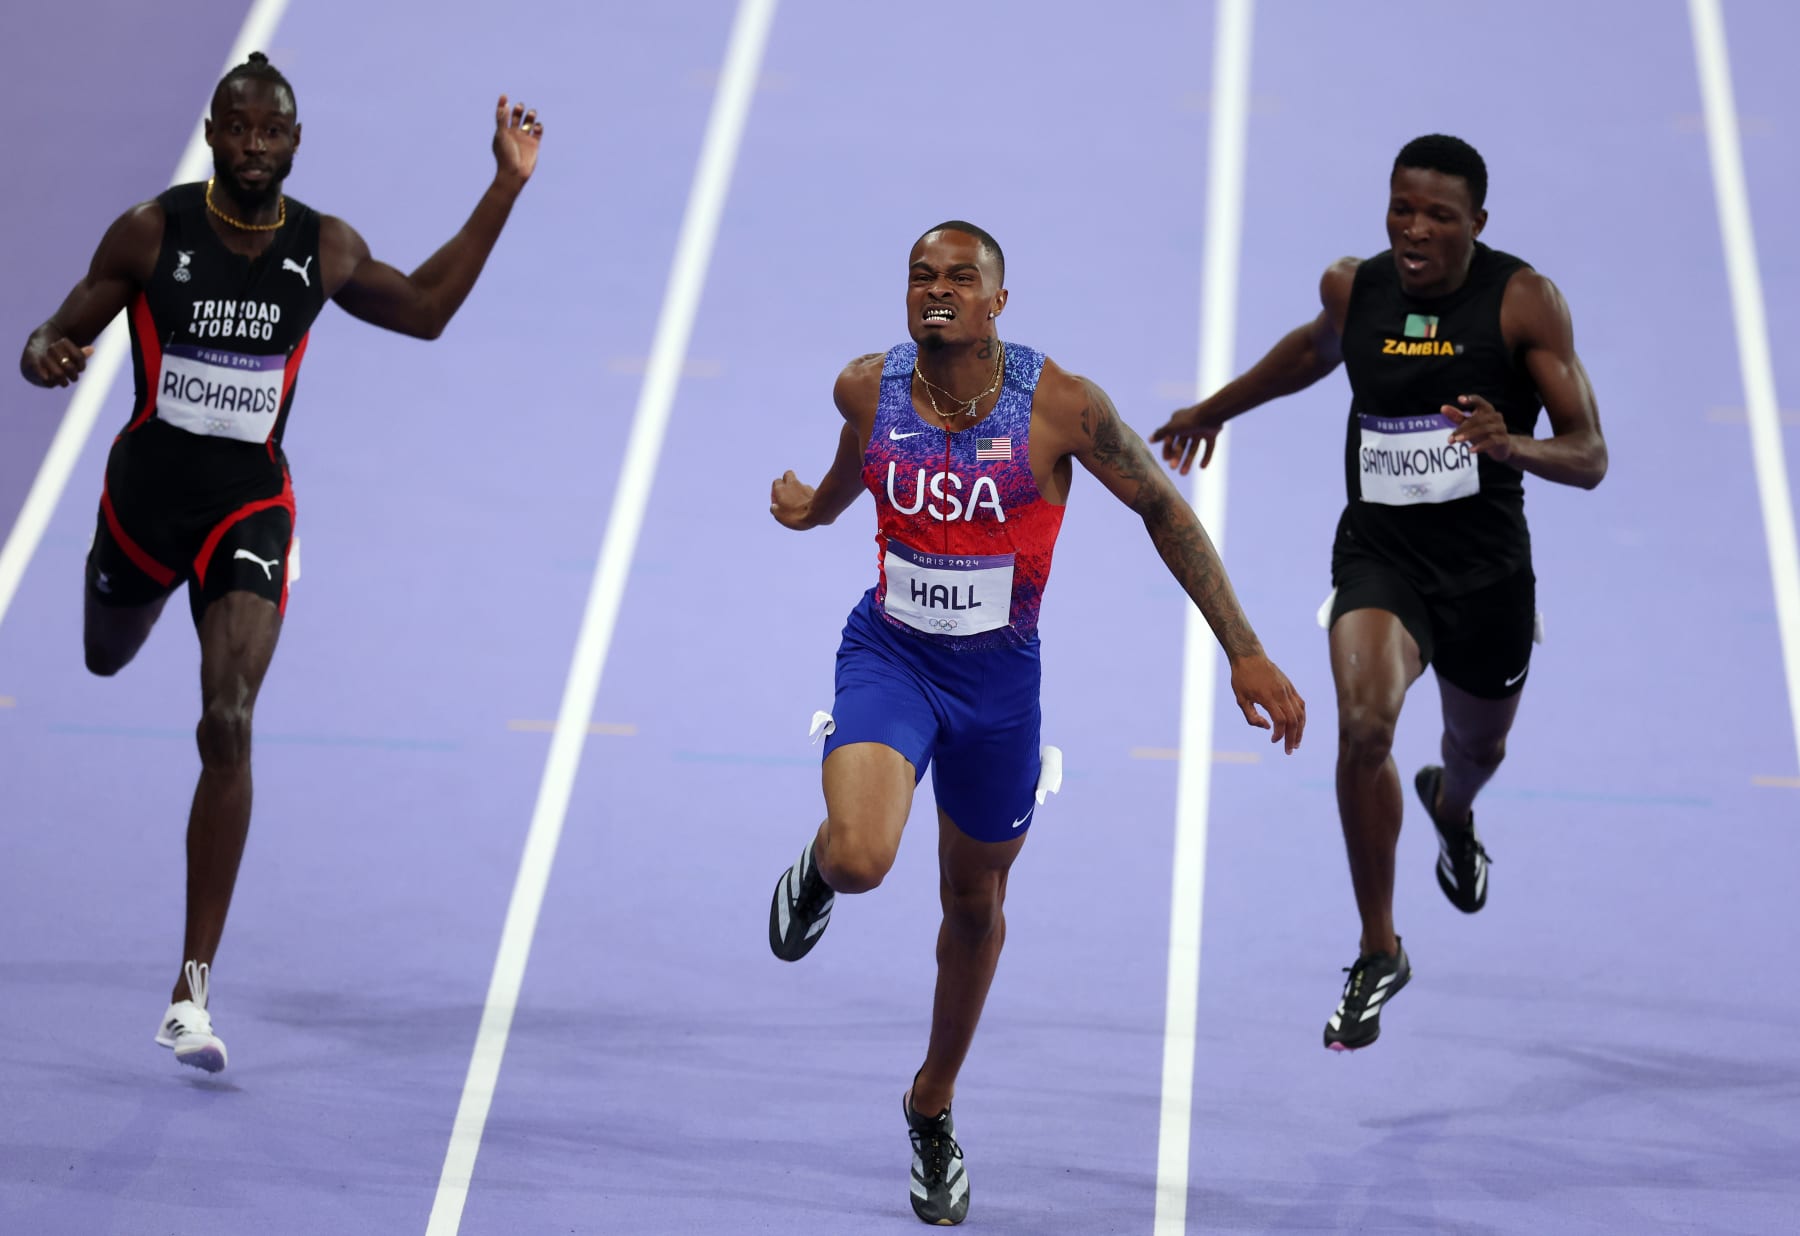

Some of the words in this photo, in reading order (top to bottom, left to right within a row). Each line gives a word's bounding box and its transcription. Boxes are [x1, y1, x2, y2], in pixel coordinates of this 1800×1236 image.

[192, 300, 281, 324] TRINIDAD
[197, 350, 229, 362] PARIS
[232, 356, 262, 368] 2024
[1382, 339, 1455, 356] ZAMBIA
[163, 371, 277, 413] RICHARDS
[1377, 421, 1405, 431] PARIS
[1408, 419, 1439, 431] 2024
[1362, 442, 1472, 477] SAMUKONGA
[887, 461, 1006, 523] USA
[913, 553, 944, 566] PARIS
[948, 558, 980, 567] 2024
[911, 578, 982, 611] HALL
